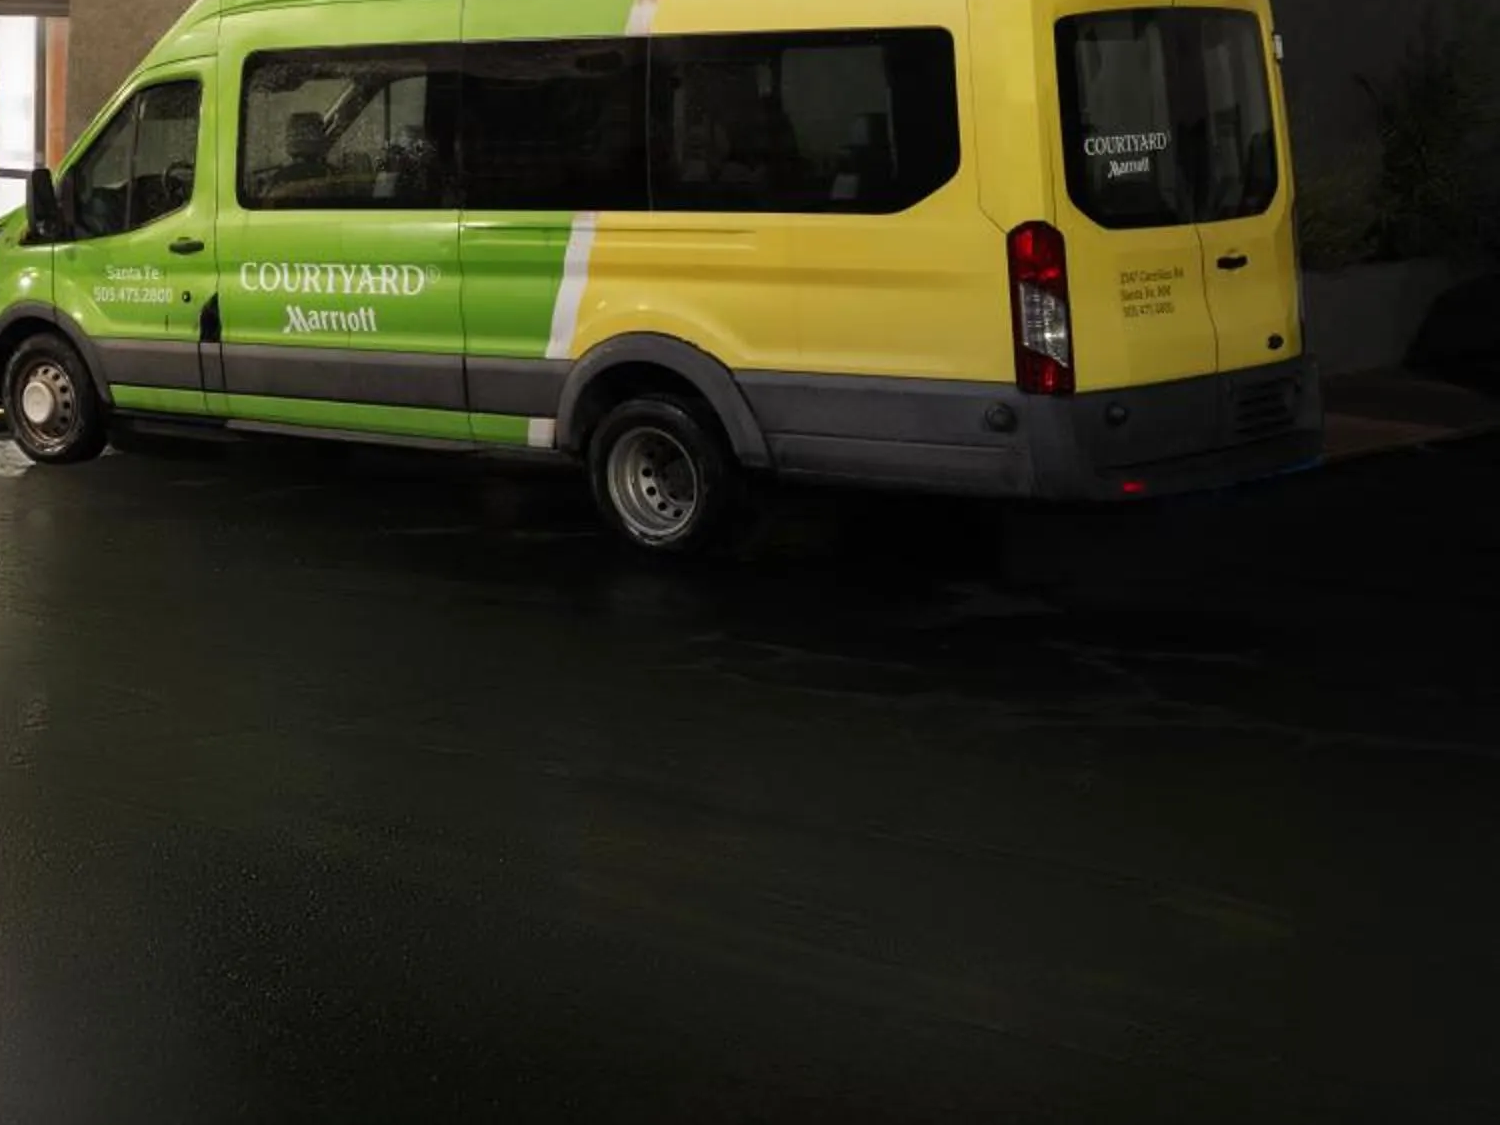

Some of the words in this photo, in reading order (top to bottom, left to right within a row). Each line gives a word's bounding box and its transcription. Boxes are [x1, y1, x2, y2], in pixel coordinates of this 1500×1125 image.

[1083, 132, 1167, 156] COURTYARD
[105, 264, 142, 281] Santa
[239, 261, 425, 296] COURTYARD
[282, 304, 378, 335] Marriott
